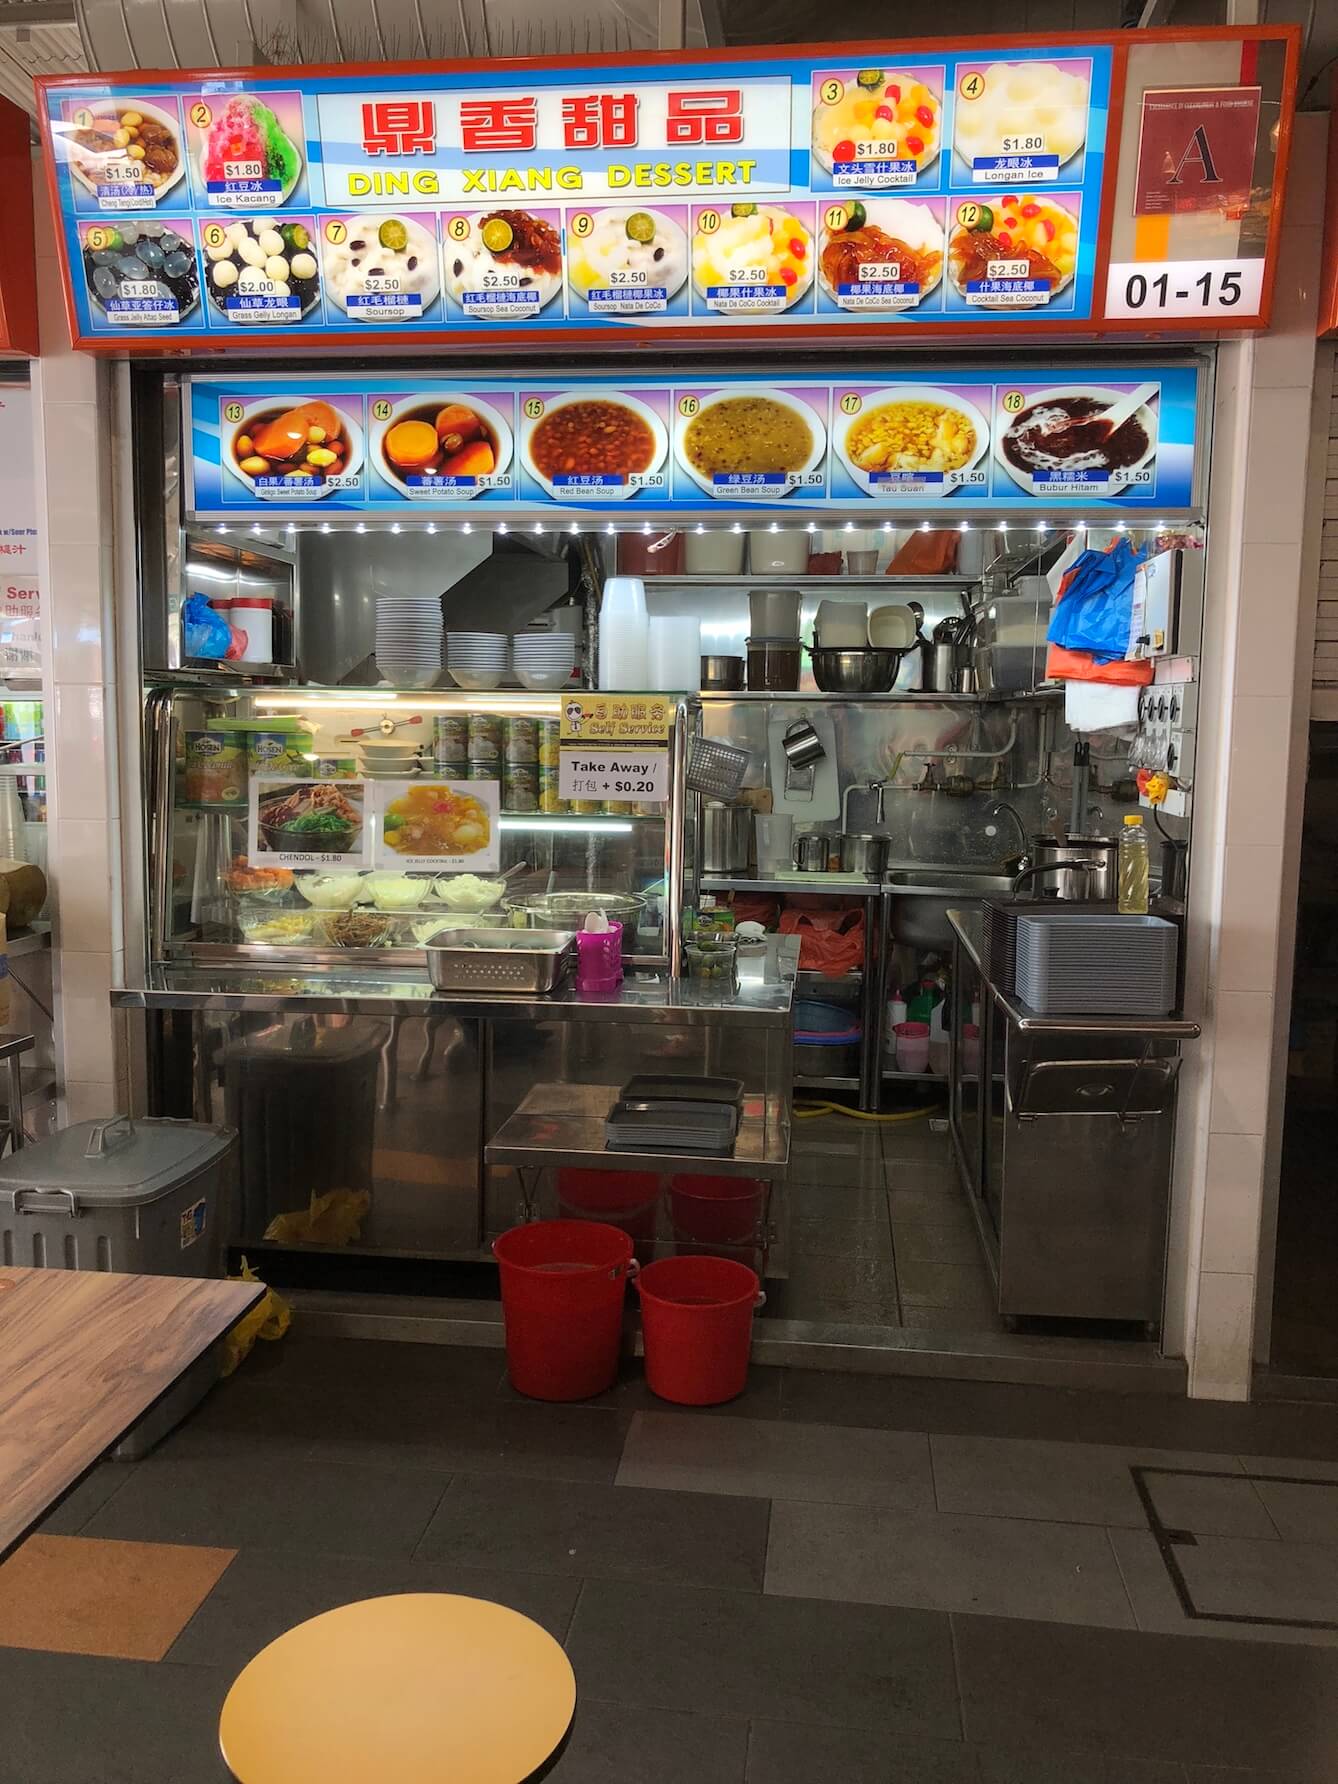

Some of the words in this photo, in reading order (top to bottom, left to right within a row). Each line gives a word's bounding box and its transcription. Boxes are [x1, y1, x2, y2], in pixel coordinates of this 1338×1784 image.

[827, 83, 838, 100] 3
[966, 77, 978, 94] 4
[79, 111, 86, 126] 1
[196, 106, 206, 124] 2
[361, 89, 745, 155] 鼎香甜品
[857, 142, 895, 155] $1.80
[1003, 137, 1042, 150] $1.80
[1166, 124, 1223, 184] A
[106, 167, 140, 179] $1.50
[225, 164, 261, 176] $1.80
[984, 171, 1024, 180] Longan
[1028, 170, 1044, 178] Ice
[347, 170, 439, 196] DING
[463, 166, 583, 194] XIANG
[608, 160, 757, 189] DESSERT
[854, 176, 874, 185] Jelly
[877, 175, 913, 183] Cocktail
[216, 195, 232, 203] Ice
[236, 195, 276, 206] Kacang
[828, 210, 842, 226] 11
[961, 207, 976, 223] 12
[578, 217, 588, 232] 9
[702, 214, 716, 229] 10
[210, 228, 220, 243] 6
[332, 225, 342, 240] 7
[454, 222, 464, 237] 8
[93, 231, 102, 246] 5
[729, 269, 766, 281] $2.50
[861, 266, 898, 278] $2.50
[989, 264, 1027, 276] $2.50
[483, 276, 518, 287] $2.50
[610, 272, 646, 283] $2.50
[123, 284, 157, 296] $1.80
[240, 281, 274, 292] $2.00
[365, 279, 399, 290] $2.50
[1125, 271, 1243, 309] 01-15
[756, 299, 779, 307] Cocktail
[972, 295, 998, 303] Cocktail
[1016, 294, 1044, 302] Coconut
[232, 311, 252, 319] Grass
[272, 310, 297, 319] Longan
[366, 308, 405, 317] Soursop
[496, 305, 508, 313] Sea
[509, 304, 536, 312] Coconut
[683, 399, 696, 413] 16
[844, 397, 858, 410] 17
[1007, 394, 1021, 409] 18
[228, 406, 241, 419] 13
[376, 404, 388, 417] 14
[527, 401, 541, 415] 15
[327, 477, 359, 488] $2.50
[479, 476, 511, 486] $1.50
[630, 475, 663, 486] $1.50
[789, 474, 823, 485] $1.50
[950, 472, 985, 483] $1.50
[1115, 471, 1150, 483] $1.50
[456, 488, 474, 496] Soup
[596, 487, 614, 496] Soup
[717, 486, 739, 494] Green
[741, 486, 759, 494] Bean
[761, 486, 780, 495] Soup
[589, 721, 616, 736] Self
[618, 721, 665, 735] Service
[571, 761, 605, 772] Take
[610, 762, 648, 775] Away
[652, 763, 657, 774] /
[572, 779, 597, 792] 打包
[602, 782, 610, 790] +
[615, 781, 654, 793] $0.20
[279, 853, 314, 861] CHENDOL
